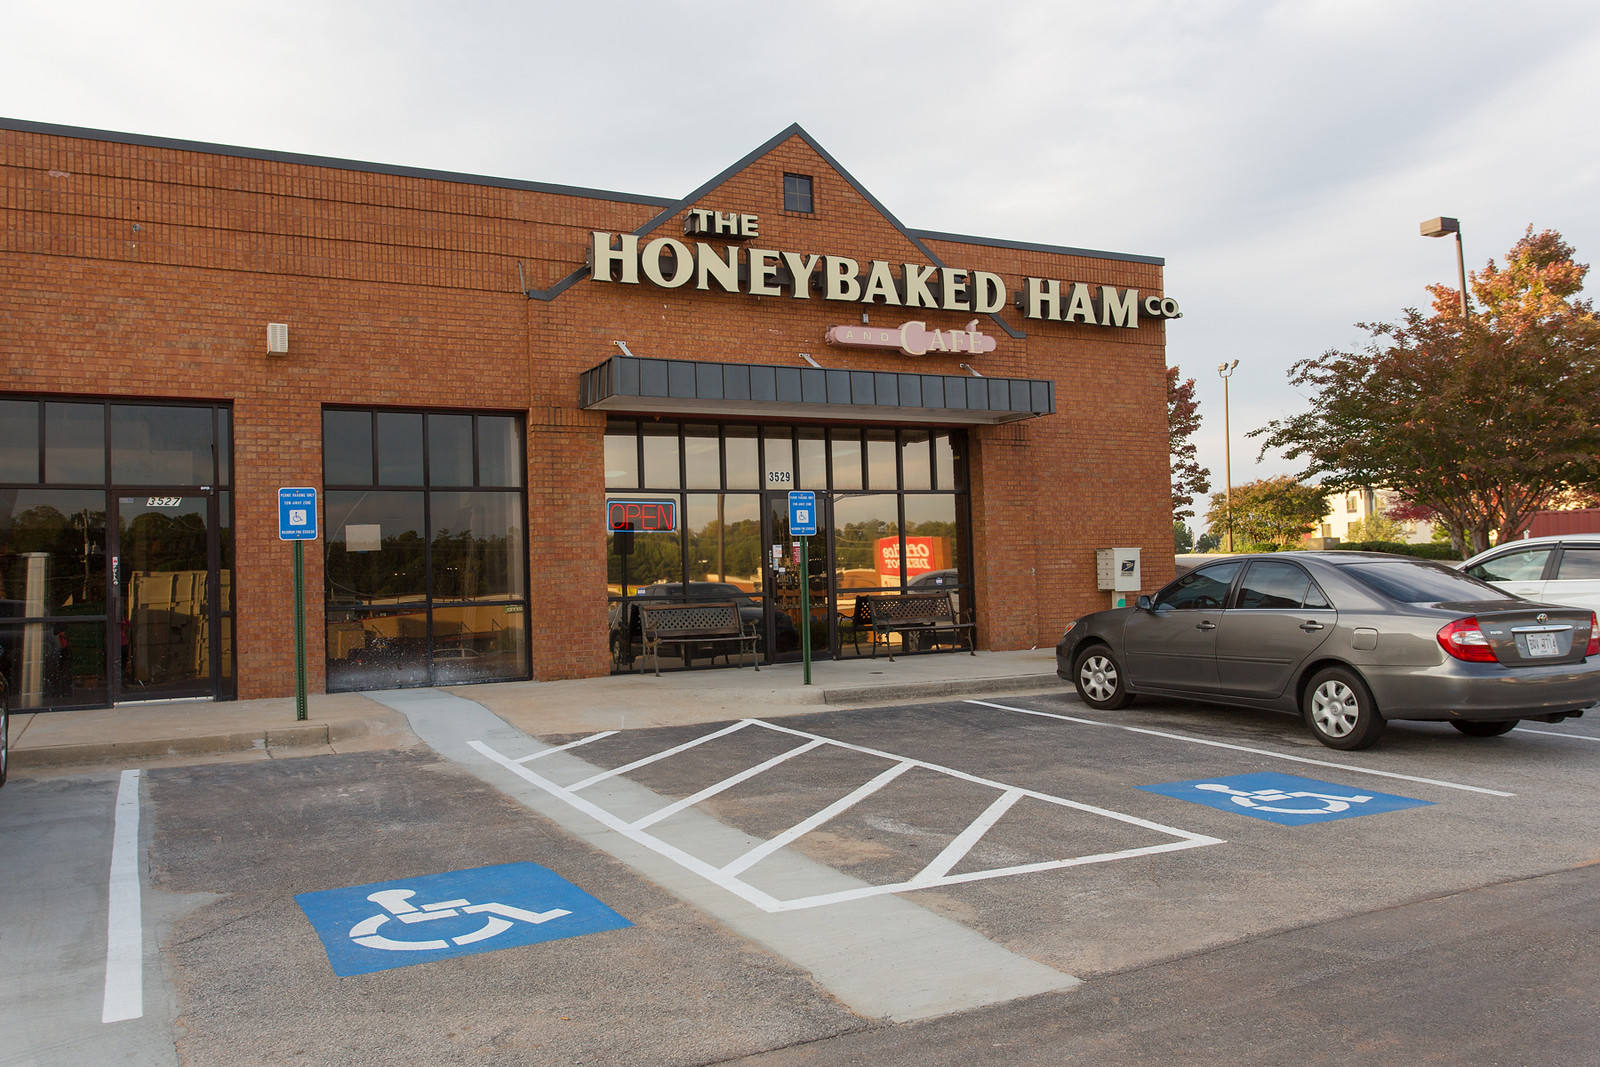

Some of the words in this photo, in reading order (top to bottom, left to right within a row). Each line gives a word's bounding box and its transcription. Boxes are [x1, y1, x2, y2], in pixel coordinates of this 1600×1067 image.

[690, 208, 759, 237] THE
[591, 231, 1007, 314] HONEYBAKED
[1025, 277, 1140, 329] HAM
[1144, 295, 1183, 318] CO.
[845, 330, 889, 342] AND
[769, 471, 791, 482] 3529
[148, 496, 181, 506] 3527
[610, 503, 673, 530] OPEN
